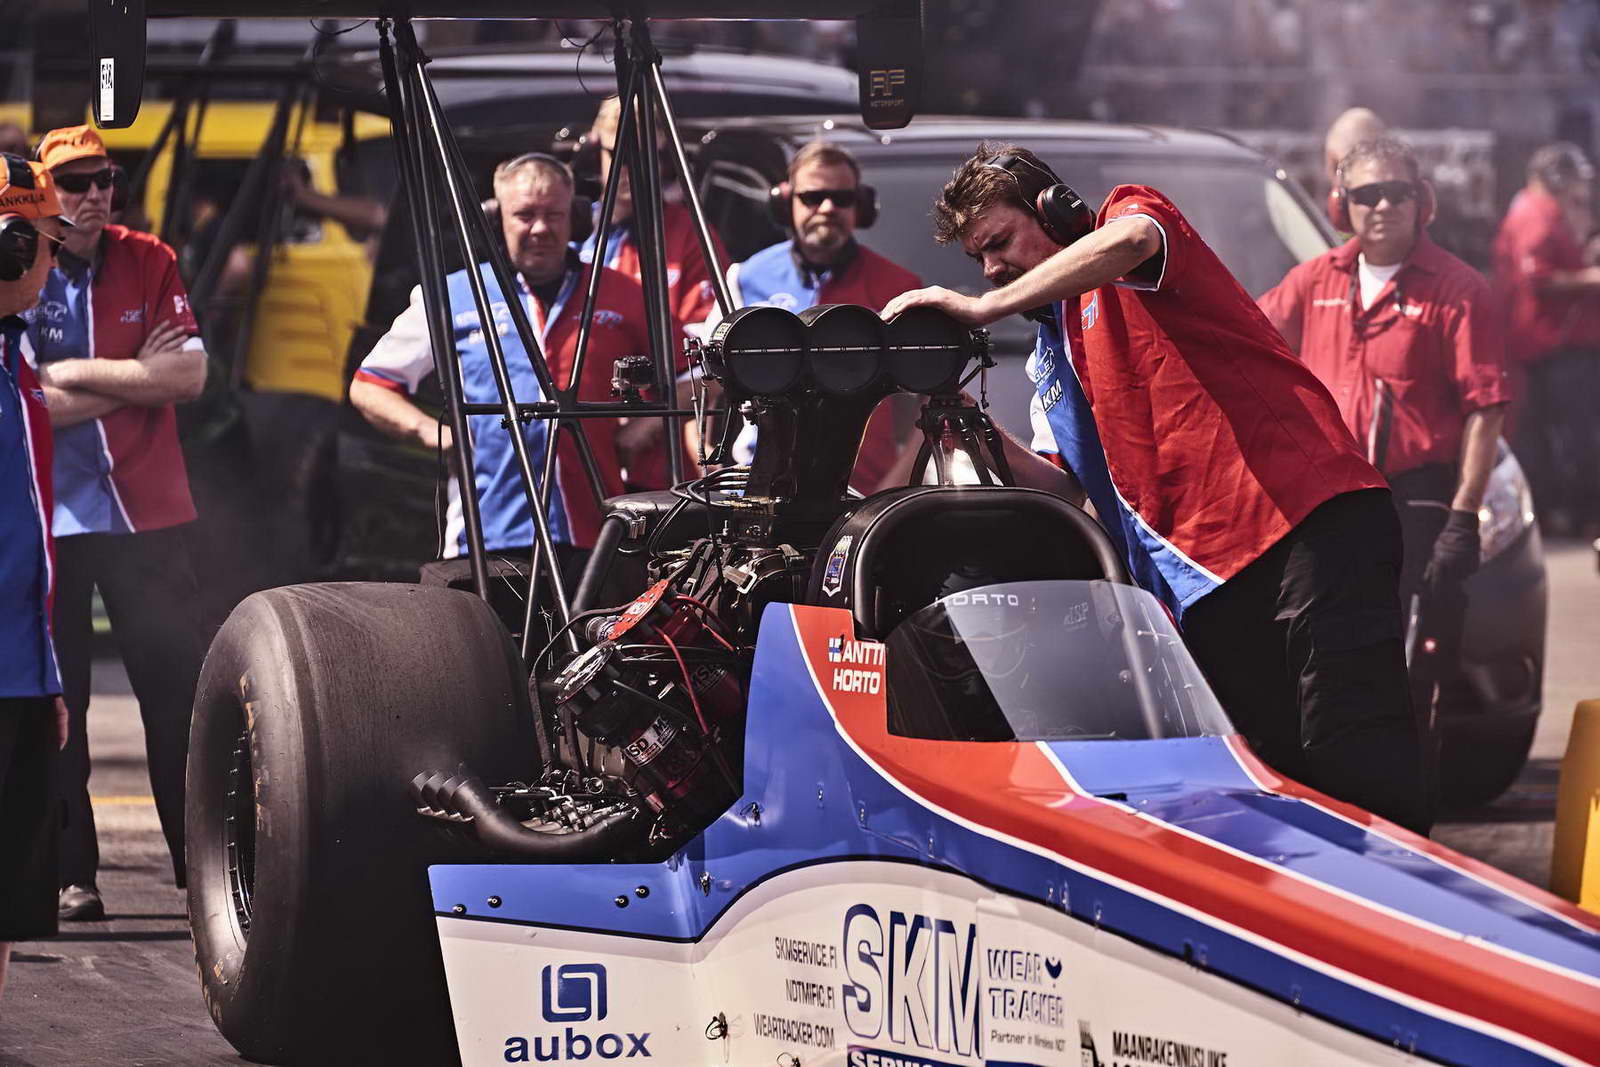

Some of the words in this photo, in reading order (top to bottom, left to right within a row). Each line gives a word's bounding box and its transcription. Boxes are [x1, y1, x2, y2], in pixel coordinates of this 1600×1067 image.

[842, 642, 887, 666] ANTTI
[832, 667, 882, 695] HORTO
[774, 936, 838, 969] SKMSERVICE.FI
[987, 948, 1042, 985] WEAR
[842, 903, 982, 1060] SKM
[988, 986, 1065, 1028] TRACKER
[503, 1027, 653, 1064] aubox
[991, 1029, 1026, 1045] Partner
